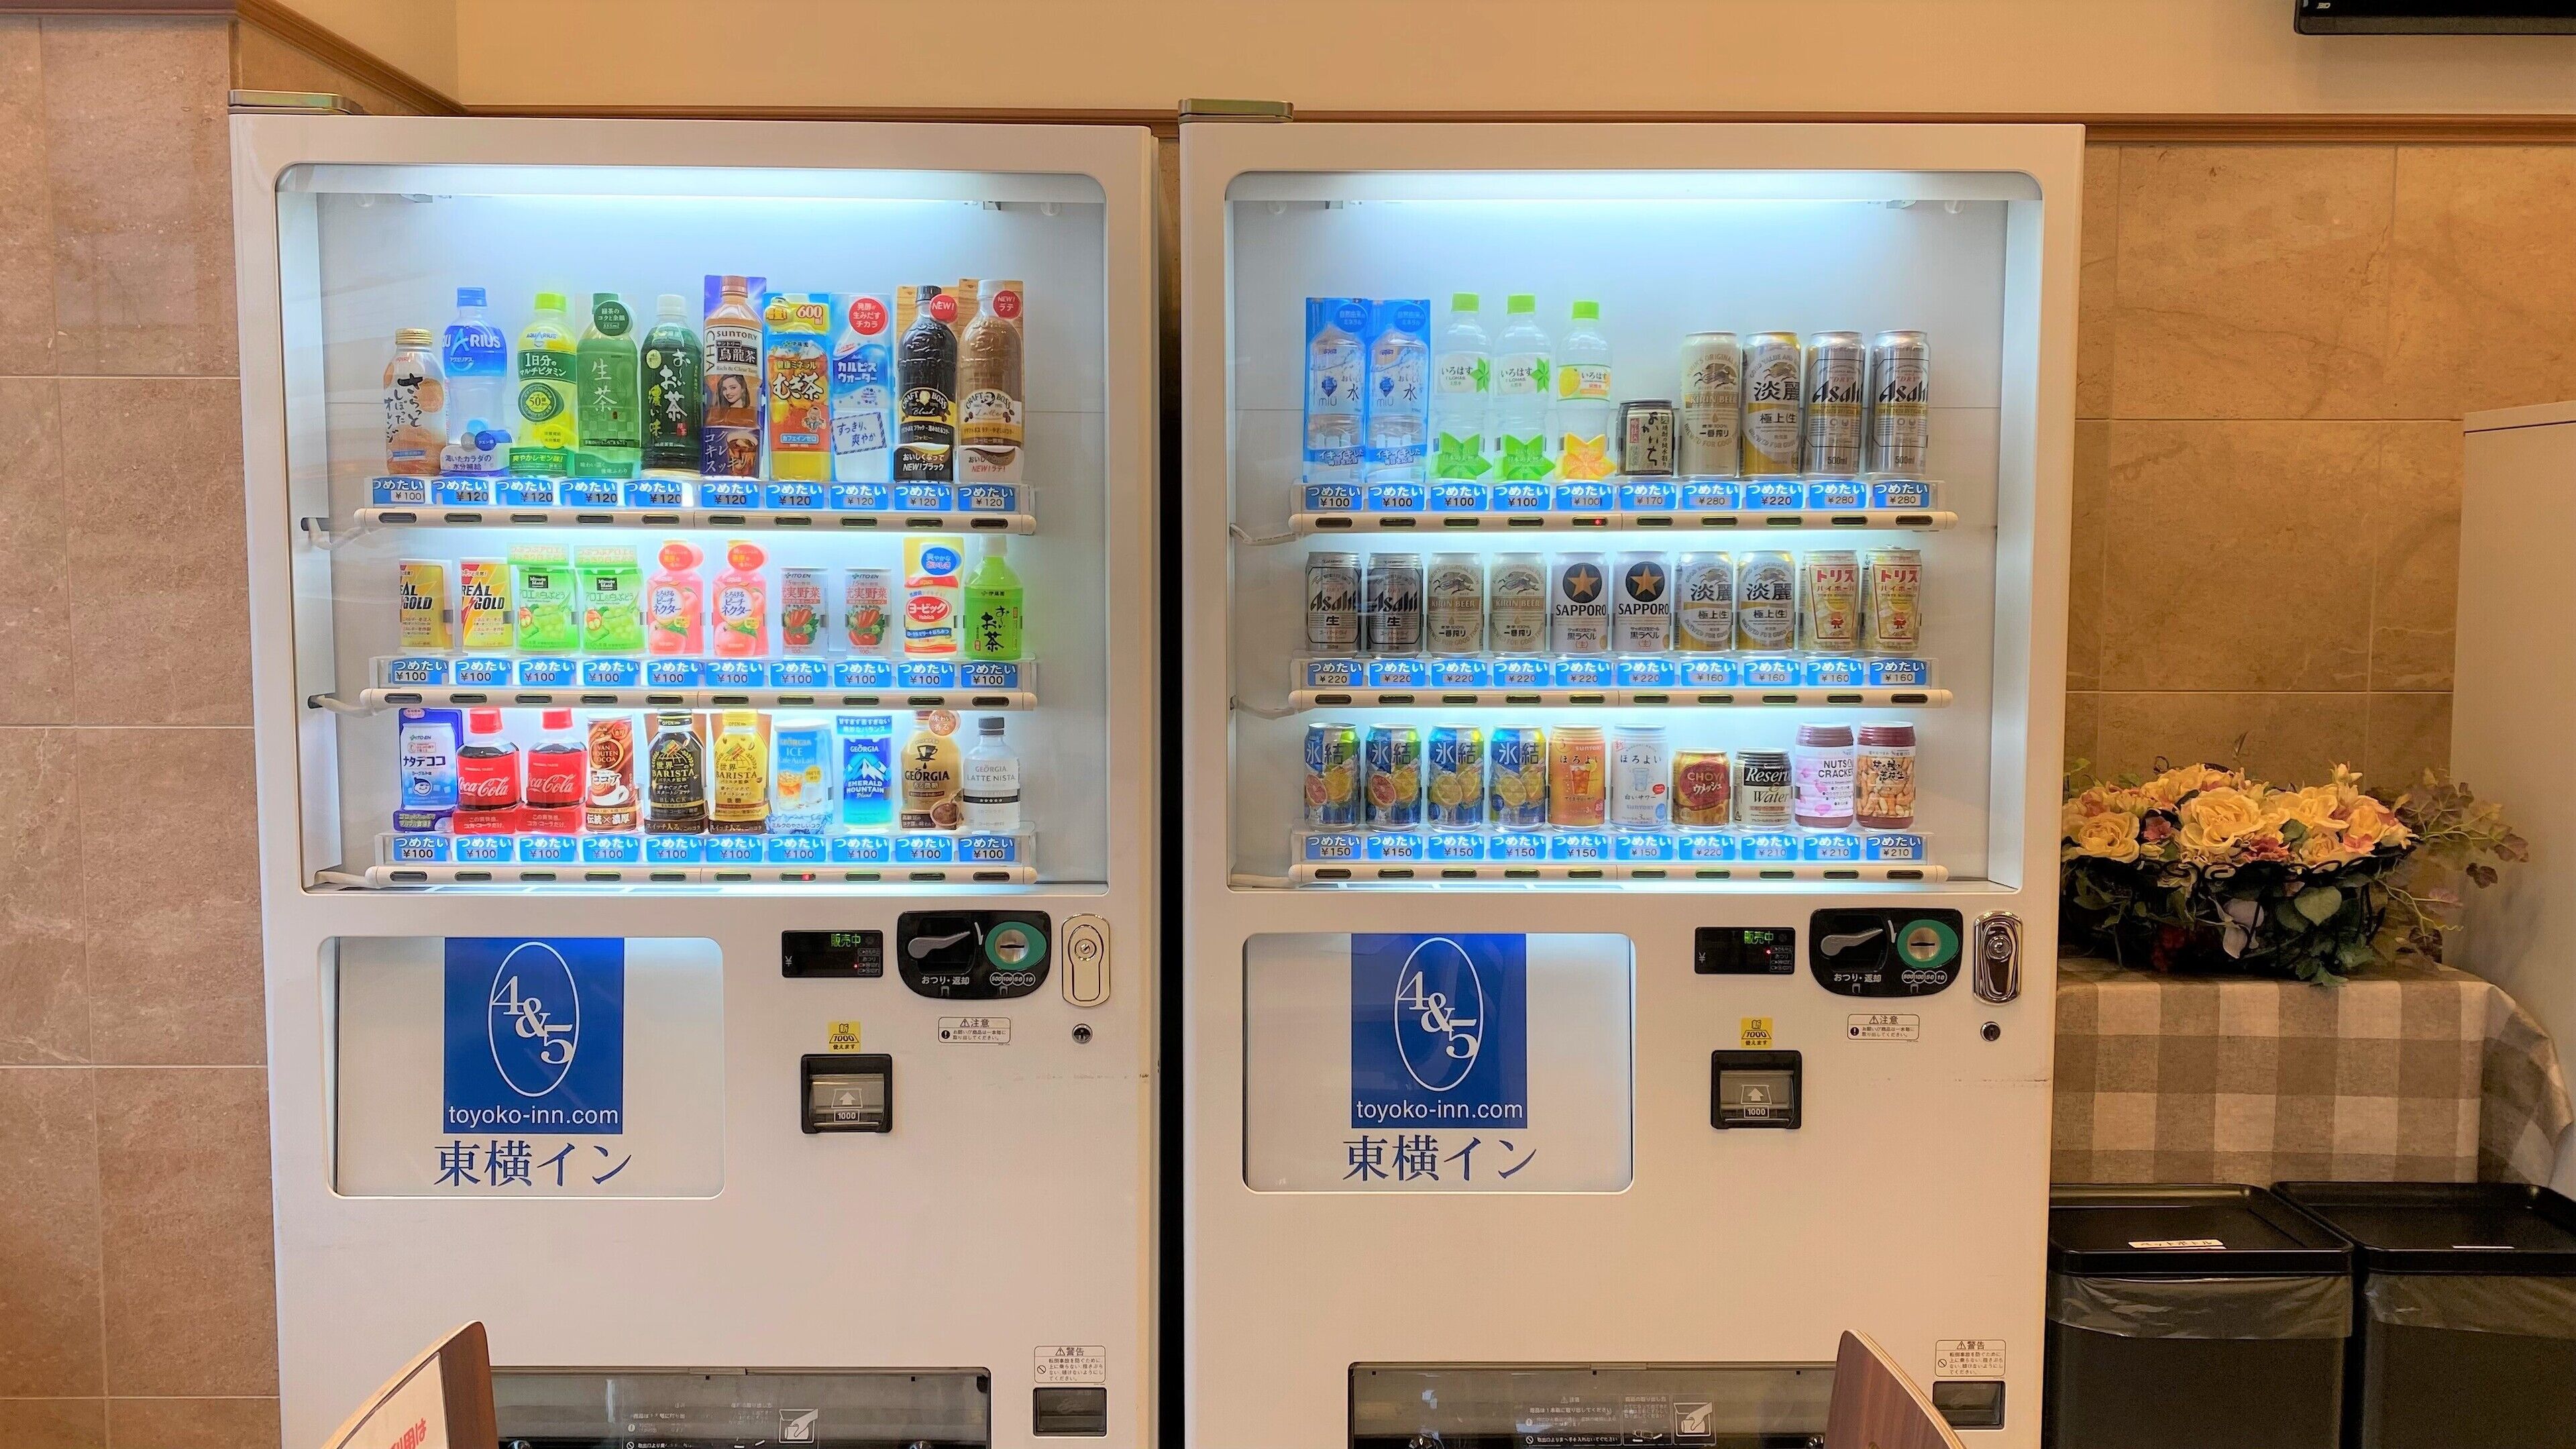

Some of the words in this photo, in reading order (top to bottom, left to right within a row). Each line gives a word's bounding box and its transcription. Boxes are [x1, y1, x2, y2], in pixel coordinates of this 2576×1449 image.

[932, 302, 955, 310] NEW!
[999, 303, 1014, 311] ラテ
[796, 305, 823, 318] 600
[853, 311, 881, 319] 生みだす
[717, 331, 757, 340] SUNTORY
[525, 353, 556, 367] 1日分の
[718, 348, 757, 363] 烏龍茶
[519, 368, 566, 376] マルチビタミン
[838, 362, 877, 372] カルピス
[1442, 366, 1473, 376] いろはす
[1501, 367, 1532, 377] いろはす
[838, 373, 877, 383] ウォーター
[591, 358, 617, 412] 生茶
[772, 372, 824, 401] むぎ茶
[659, 365, 688, 422] お茶
[1347, 384, 1359, 401] 水
[1403, 384, 1417, 401] 水
[1754, 381, 1800, 401] 淡麗
[1812, 379, 1863, 403] Asahi
[1879, 379, 1929, 403] Asahi
[902, 392, 919, 410] CRAFT
[931, 392, 947, 409] BOSS
[965, 393, 983, 410] CRAFT
[996, 394, 1012, 409] BOSS
[648, 384, 663, 438] 濃い味
[704, 430, 728, 443] コク
[1699, 429, 1729, 437] 一番搾り
[704, 445, 728, 458] キレ
[704, 456, 747, 473] スッキリ
[1827, 457, 1847, 465] 500ml
[1894, 456, 1915, 465] 500ml
[433, 480, 488, 491] つめたい
[705, 483, 758, 494] つめたい
[832, 484, 887, 496] つめたい
[1621, 484, 1676, 495] つめたい
[1748, 484, 1803, 494] つめたい
[1875, 483, 1929, 494] つめたい
[959, 486, 1013, 498] つめたい
[1307, 486, 1361, 496] つめたい
[457, 492, 488, 502] ¥120
[714, 495, 747, 506] ¥120
[847, 497, 874, 506] ¥120
[1636, 496, 1663, 504] ¥170
[1761, 496, 1792, 506] ¥220
[1889, 496, 1916, 504] ¥280
[976, 498, 1002, 507] ¥120
[1320, 498, 1350, 507] ¥100
[1817, 570, 1854, 583] トリス
[1880, 570, 1918, 584] トリス
[1690, 584, 1732, 601] 淡麗
[1746, 583, 1792, 600] 淡麗
[403, 596, 433, 610] GOLD
[474, 596, 505, 610] GOLD
[655, 596, 675, 605] ピーチ
[1309, 590, 1356, 612] Asahi
[1372, 590, 1418, 612] Asahi
[653, 606, 682, 614] ネクター
[722, 606, 751, 616] ネクター
[908, 602, 945, 614] ヨービック
[1556, 604, 1606, 616] SAPPORO
[1618, 603, 1669, 615] SAPPORO
[1326, 616, 1340, 626] 生
[1387, 616, 1401, 627] 生
[981, 612, 1004, 652] お茶
[1438, 629, 1466, 637] 一番搾り
[394, 660, 449, 671] つめたい
[649, 661, 704, 672] つめたい
[900, 663, 953, 674] つめたい
[1309, 662, 1362, 673] つめたい
[1556, 661, 1609, 672] つめたい
[1682, 661, 1736, 672] つめたい
[1872, 661, 1925, 672] つめたい
[396, 672, 427, 682] ¥100
[653, 674, 684, 683] ¥100
[910, 676, 940, 685] ¥100
[1320, 675, 1348, 684] ¥220
[1570, 674, 1598, 683] ¥220
[1697, 674, 1723, 682] ¥160
[1885, 674, 1913, 682] ¥160
[934, 722, 949, 731] 香る
[786, 748, 805, 757] ICE
[850, 744, 879, 753] GEORGIA
[1306, 741, 1343, 765] 氷結
[1371, 741, 1411, 765] 氷結
[1435, 741, 1474, 765] 氷結
[1499, 741, 1540, 765] 氷結
[403, 755, 446, 767] ナタデココ
[1620, 754, 1662, 763] ほろよい
[657, 761, 689, 769] 世界一の
[720, 762, 752, 771] 世界一の
[975, 764, 1006, 772] GEORGIA
[1823, 760, 1847, 768] NUTS
[593, 773, 621, 784] ココア
[652, 769, 695, 778] BARISTA
[716, 771, 757, 780] BARISTA
[905, 767, 950, 781] GEORGIA
[1686, 772, 1725, 782] CHOYA
[459, 776, 511, 798] Coca-Cola
[1693, 782, 1722, 795] ウメッシュ
[1753, 790, 1789, 803] Water
[458, 838, 513, 849] つめたい
[584, 839, 639, 849] つめたい
[708, 839, 761, 849] つめたい
[1307, 836, 1360, 846] つめたい
[1430, 837, 1483, 846] つめたい
[1680, 837, 1734, 847] つめたい
[1868, 836, 1921, 847] つめたい
[467, 849, 496, 858] ¥100
[593, 850, 623, 859] ¥100
[720, 850, 751, 859] ¥100
[1321, 848, 1350, 857] ¥150
[1444, 848, 1473, 857] ¥150
[1696, 849, 1722, 857] ¥220
[1883, 849, 1909, 857] ¥210
[831, 934, 861, 947] 販売中
[1745, 930, 1774, 945] 販売中
[922, 975, 970, 985] おつり・返却
[1833, 973, 1882, 983] おつり・返却
[490, 975, 576, 1065] 4&5
[1397, 971, 1479, 1059] 4&5
[1880, 1015, 1899, 1025] 注意
[971, 1018, 989, 1028] 注意
[833, 1034, 855, 1042] 1000
[1746, 1030, 1767, 1038] 1000
[837, 1112, 856, 1120] 1000
[1356, 1099, 1523, 1123] toyoko-inn.com
[1747, 1108, 1766, 1116] 1000
[448, 1105, 619, 1128] toyoko-inn.com
[1342, 1134, 1537, 1182] 東横イン
[433, 1140, 632, 1187] 東横イン
[1967, 1341, 1984, 1350] 警告
[1066, 1347, 1085, 1356] 警告
